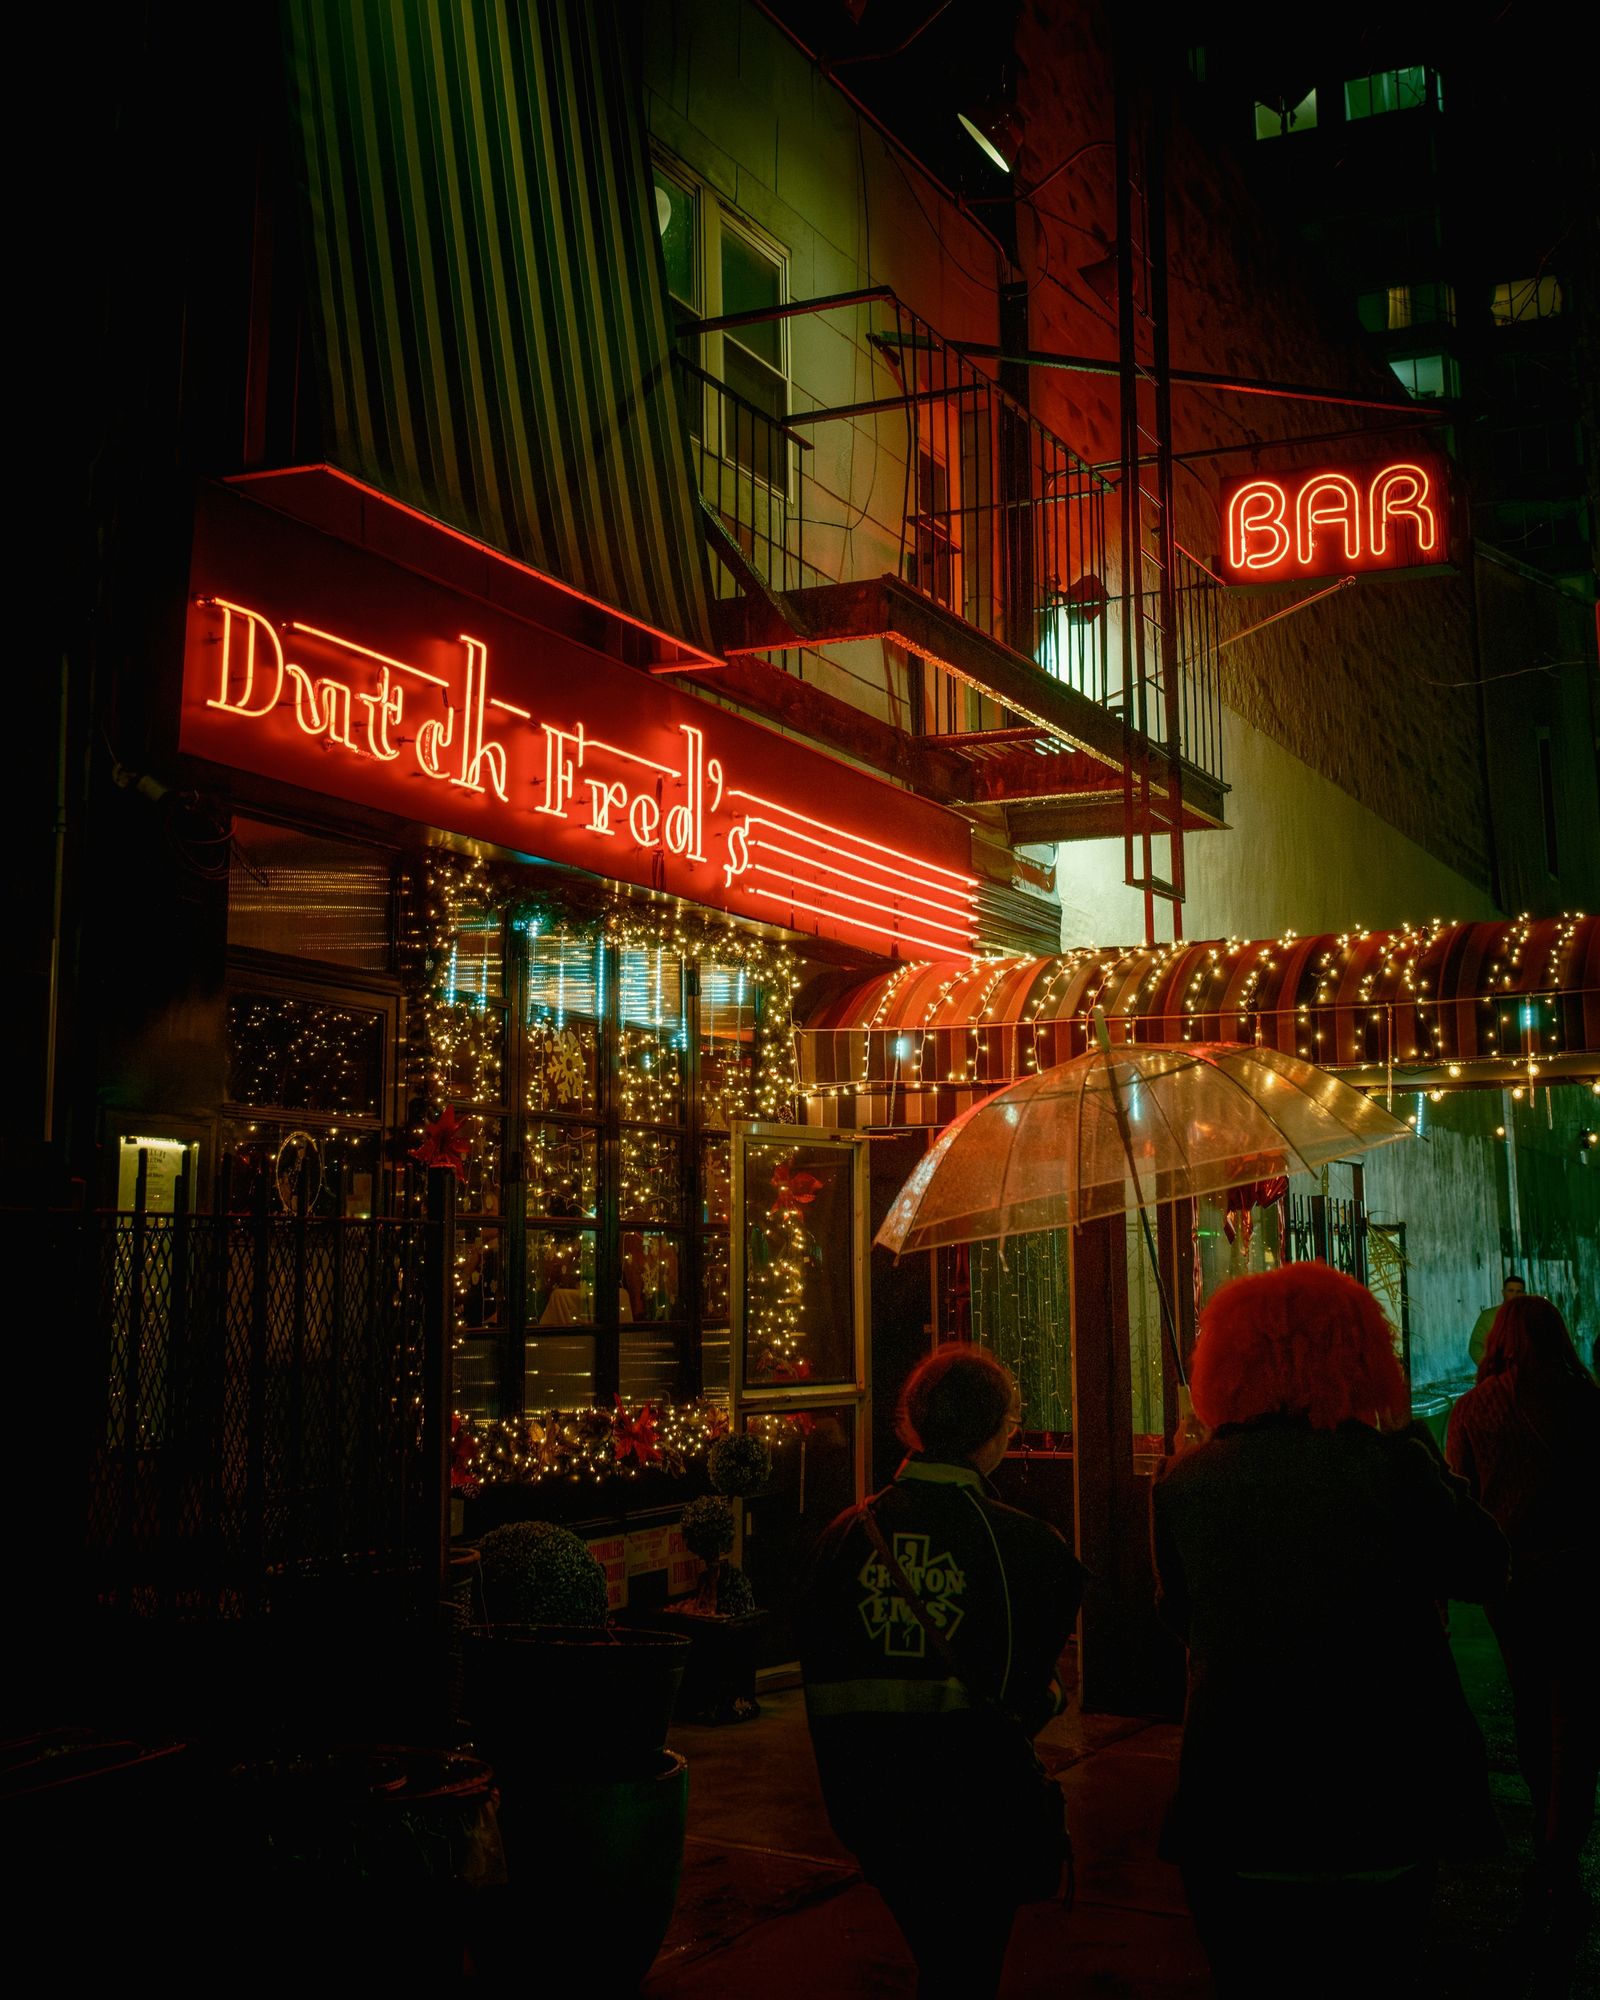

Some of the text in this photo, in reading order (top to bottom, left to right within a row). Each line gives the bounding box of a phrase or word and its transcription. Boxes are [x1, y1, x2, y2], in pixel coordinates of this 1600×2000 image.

[1229, 464, 1435, 569] BAR
[206, 597, 757, 888] Dutch Fred's
[862, 1563, 967, 1596] CRTON
